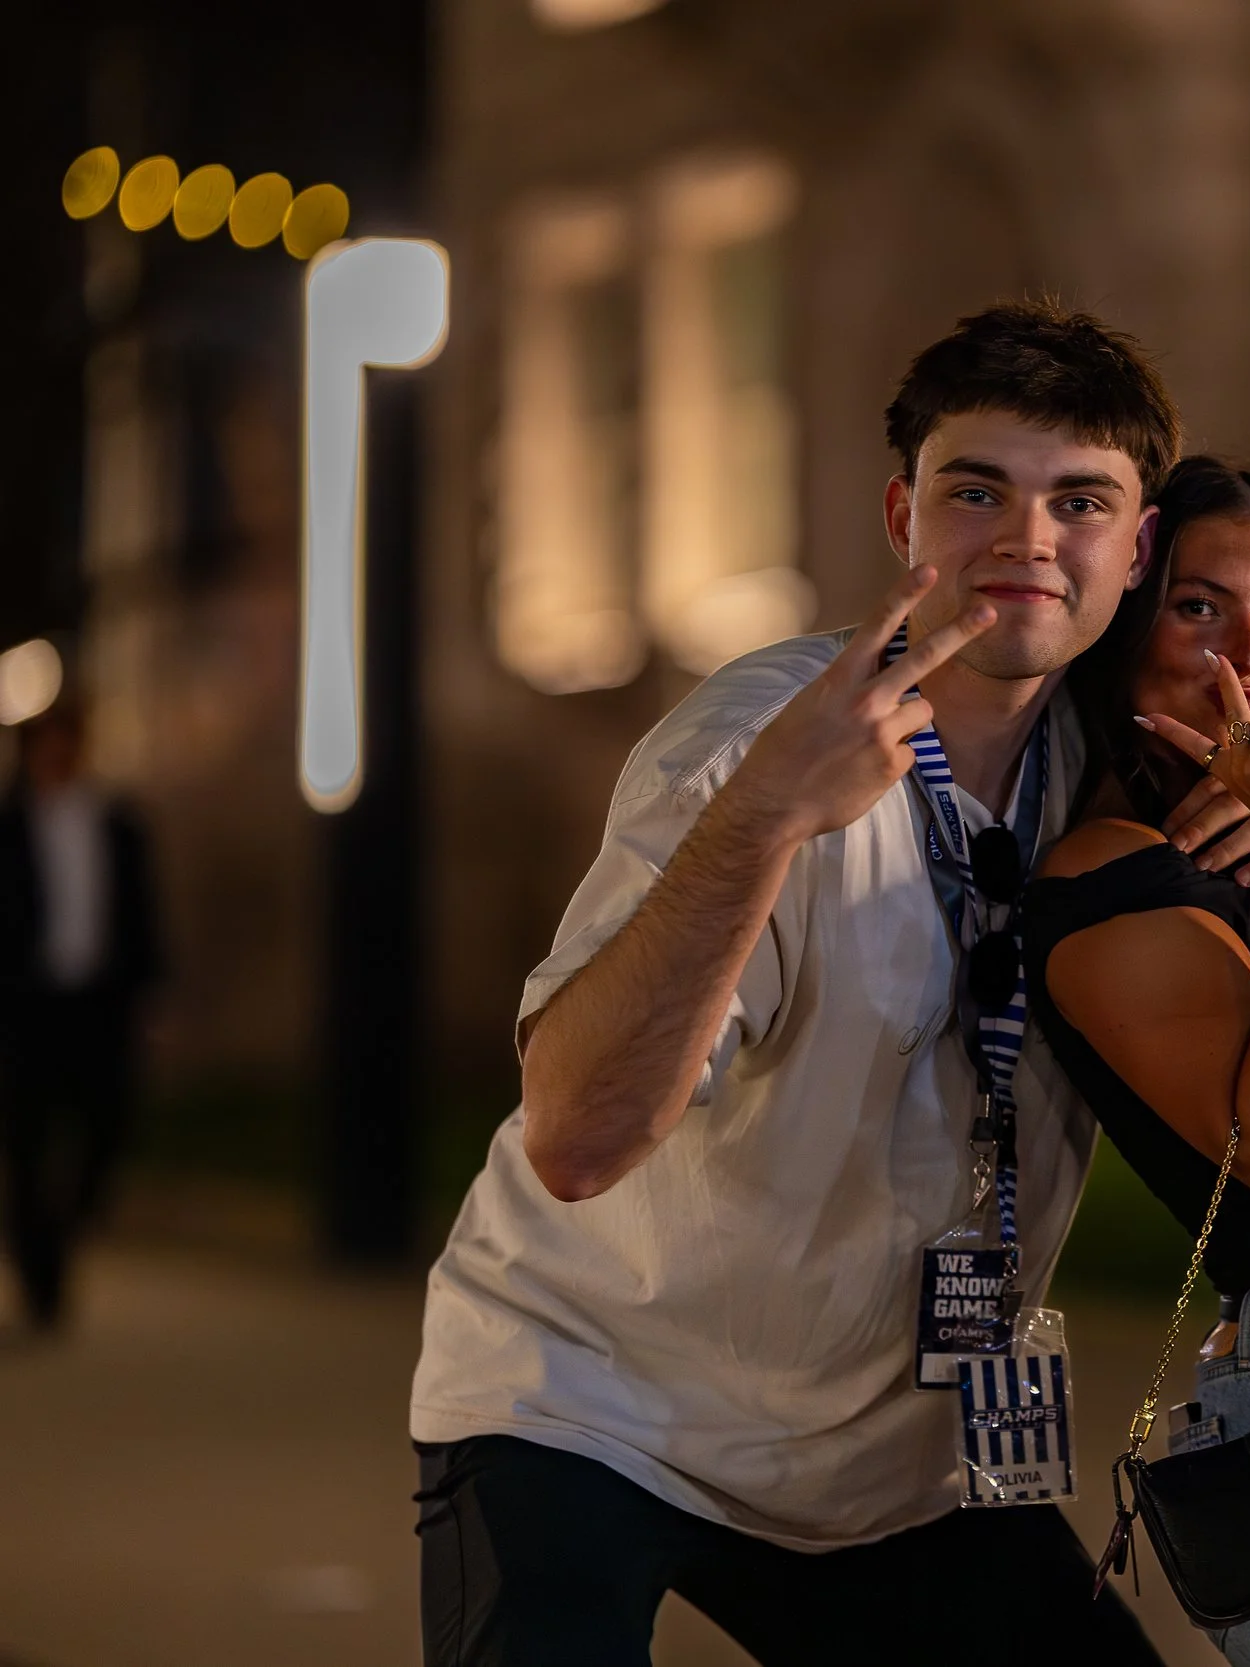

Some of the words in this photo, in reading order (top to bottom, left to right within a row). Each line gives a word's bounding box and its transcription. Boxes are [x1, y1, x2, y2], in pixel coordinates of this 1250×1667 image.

[937, 1254, 974, 1273] WE
[935, 1277, 1004, 1296] KNOW
[934, 1299, 998, 1318] GAME
[972, 1408, 1058, 1425] CHAMPS
[994, 1471, 1043, 1487] OLIVIA
